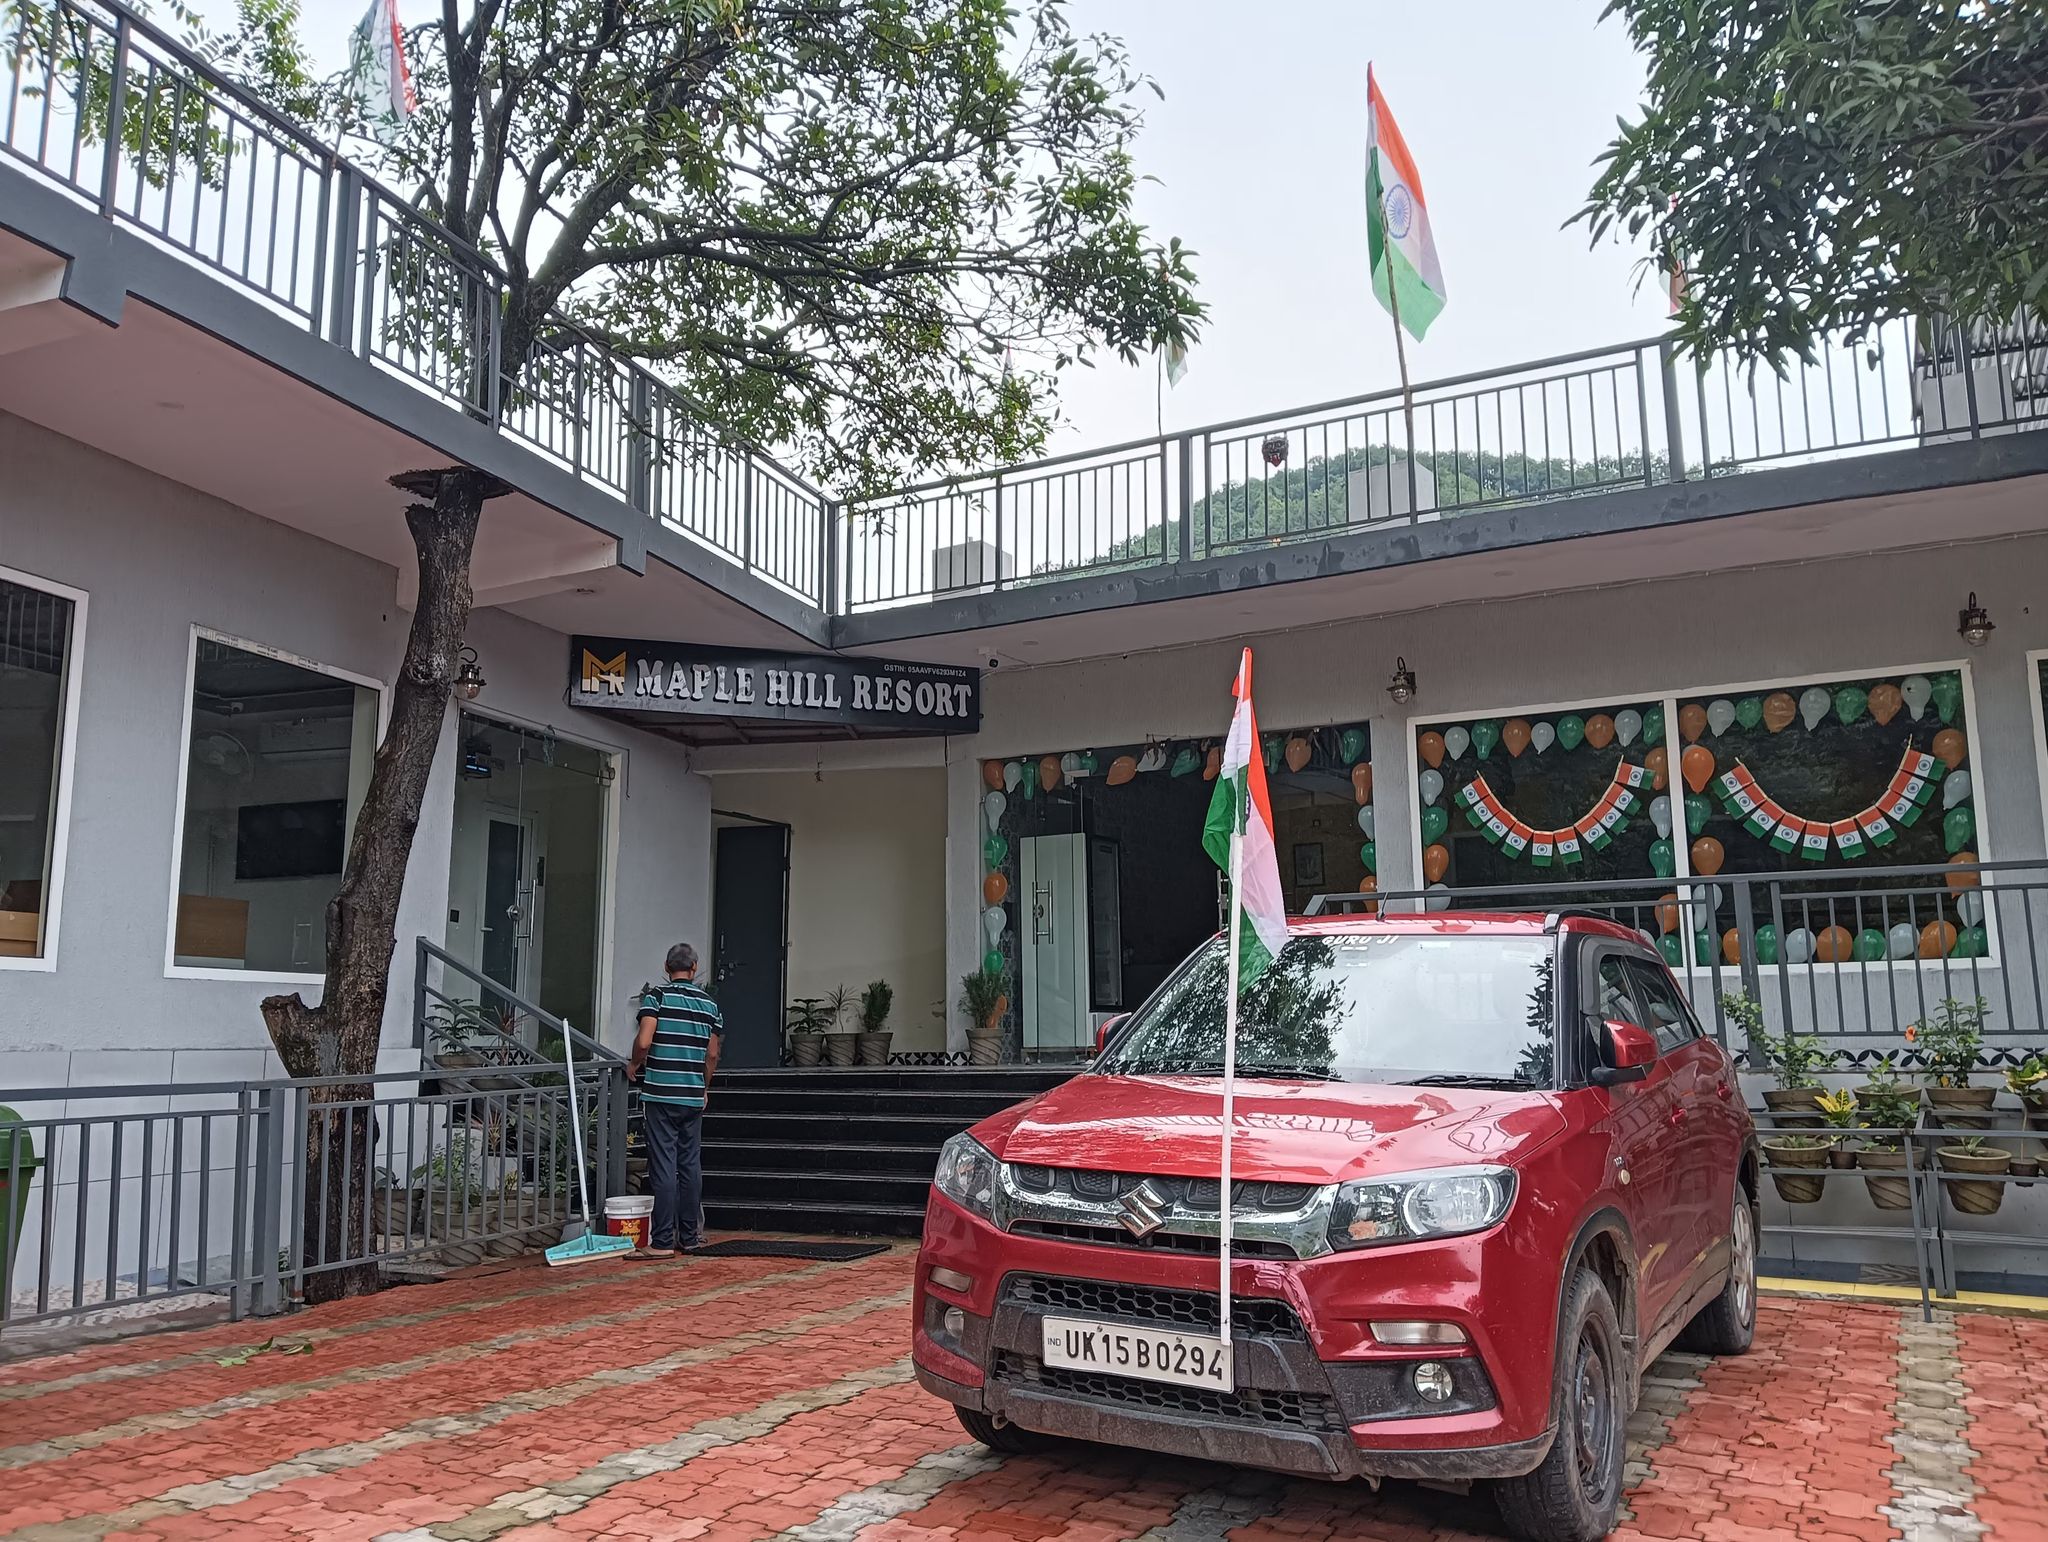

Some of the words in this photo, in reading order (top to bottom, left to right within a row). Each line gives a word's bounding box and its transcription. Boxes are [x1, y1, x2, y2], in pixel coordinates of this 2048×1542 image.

[884, 664, 907, 673] GSTIN:
[636, 659, 757, 703] MAPLE
[766, 669, 842, 709] HILL
[852, 675, 972, 718] RESORT
[1321, 935, 1373, 945] GURU
[1047, 1337, 1062, 1347] IND
[1065, 1329, 1223, 1381] UK15B0294
